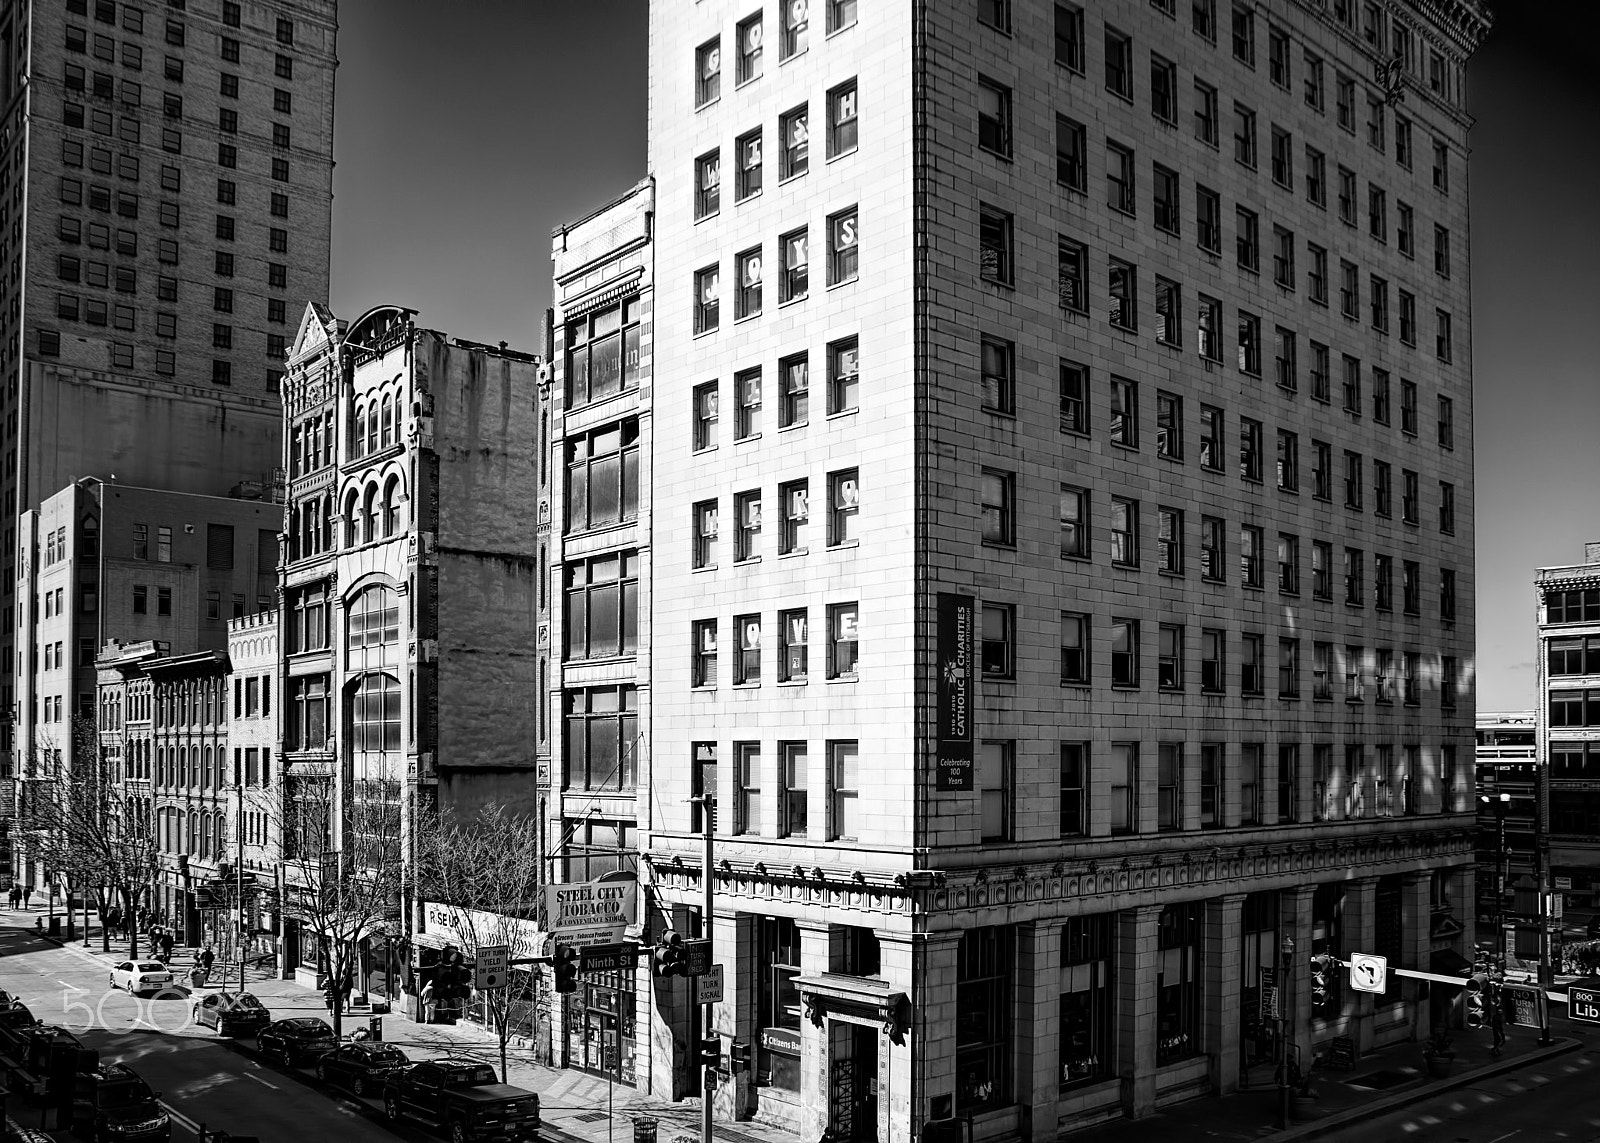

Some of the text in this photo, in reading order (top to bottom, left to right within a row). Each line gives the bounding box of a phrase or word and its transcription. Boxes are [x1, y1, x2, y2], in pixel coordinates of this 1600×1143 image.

[957, 606, 965, 736] CATHOLIC CHARITIES
[940, 758, 970, 768] Celebrating
[950, 768, 960, 776] 100
[948, 776, 963, 785] Years
[556, 886, 626, 903] STEEL CITY
[562, 901, 620, 917] TOBACCO
[564, 917, 603, 926] CONVENIENCE
[557, 934, 574, 942] Grocery
[594, 931, 613, 939] Products
[478, 949, 506, 958] LEFT TURN
[483, 958, 501, 966] YIELD
[587, 955, 632, 969] Ninth St
[478, 966, 505, 975] ON GREEN
[702, 980, 719, 990] TURN
[700, 990, 721, 1000] SIGNAL
[1512, 989, 1530, 1000] NO
[1575, 992, 1593, 1001] 800
[1515, 1007, 1530, 1016] ON
[768, 1036, 791, 1049] Citizens
